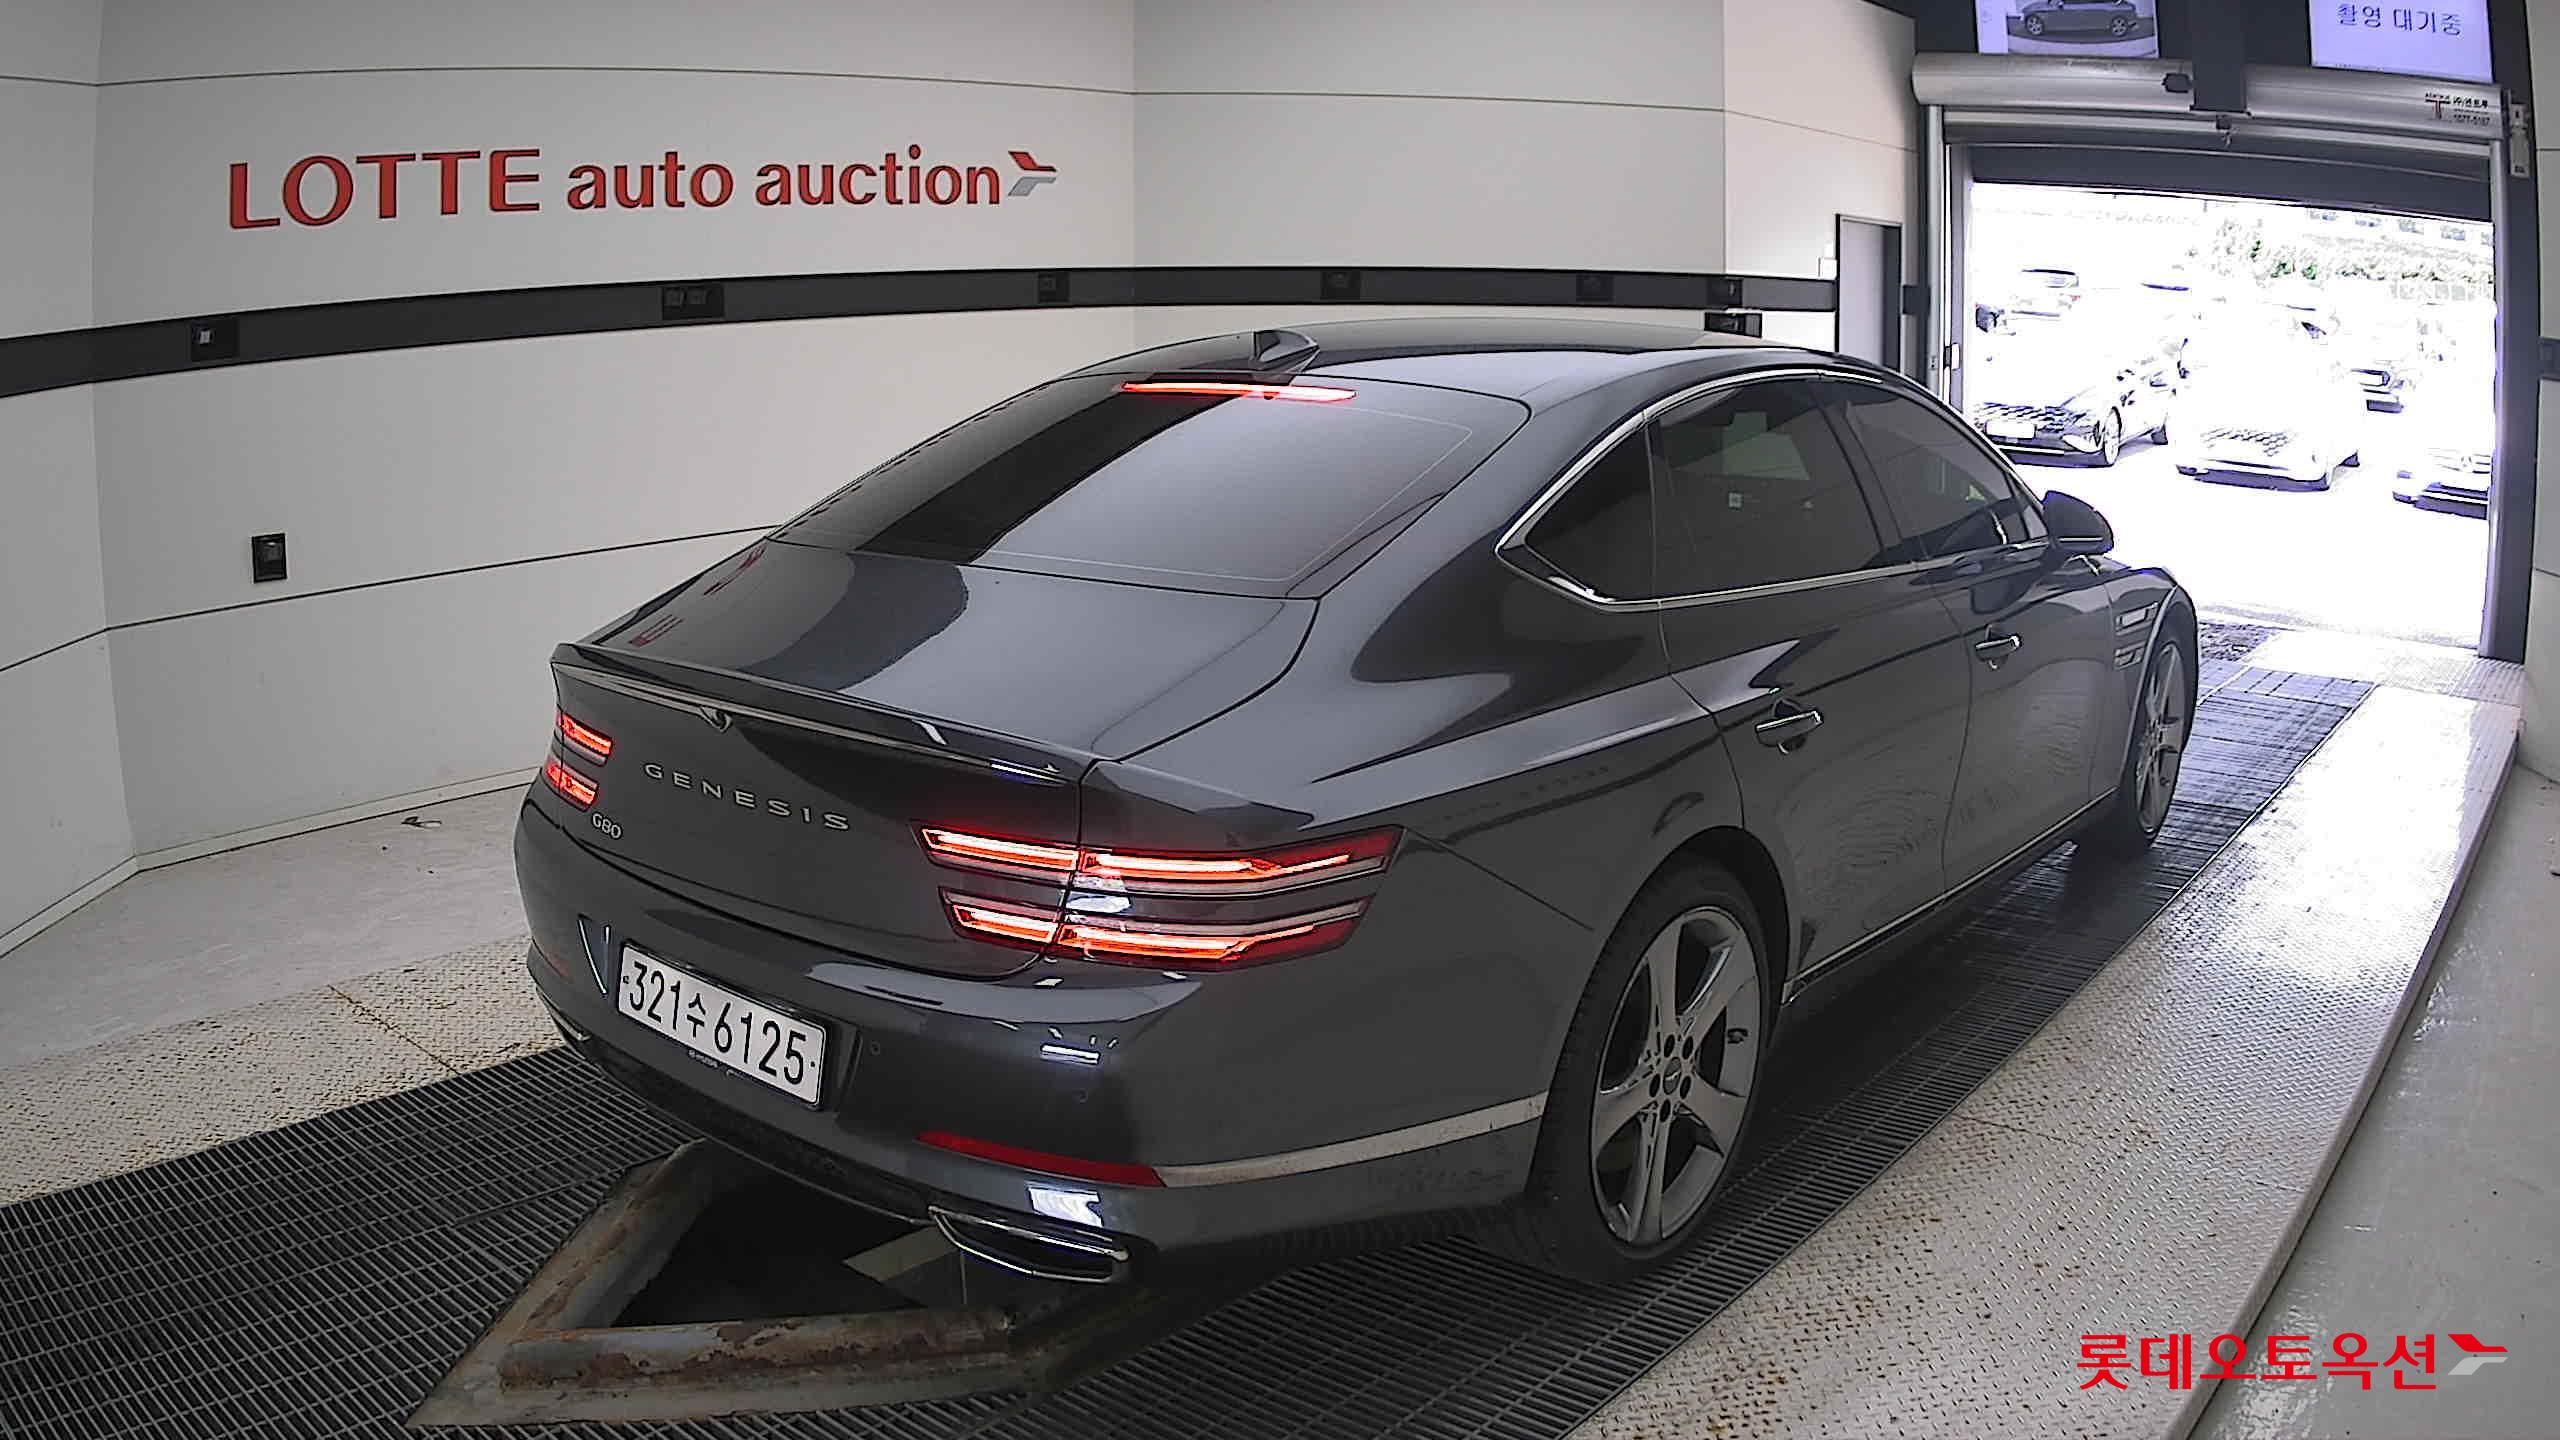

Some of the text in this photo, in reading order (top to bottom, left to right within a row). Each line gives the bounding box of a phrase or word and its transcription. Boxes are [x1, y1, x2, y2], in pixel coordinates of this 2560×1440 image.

[2338, 4, 2461, 36] 촬영 대기중
[229, 144, 1000, 230] LOTTE auto auction
[591, 813, 622, 839] G80
[643, 763, 849, 831] GENESIS
[629, 960, 807, 1085] 321수6125
